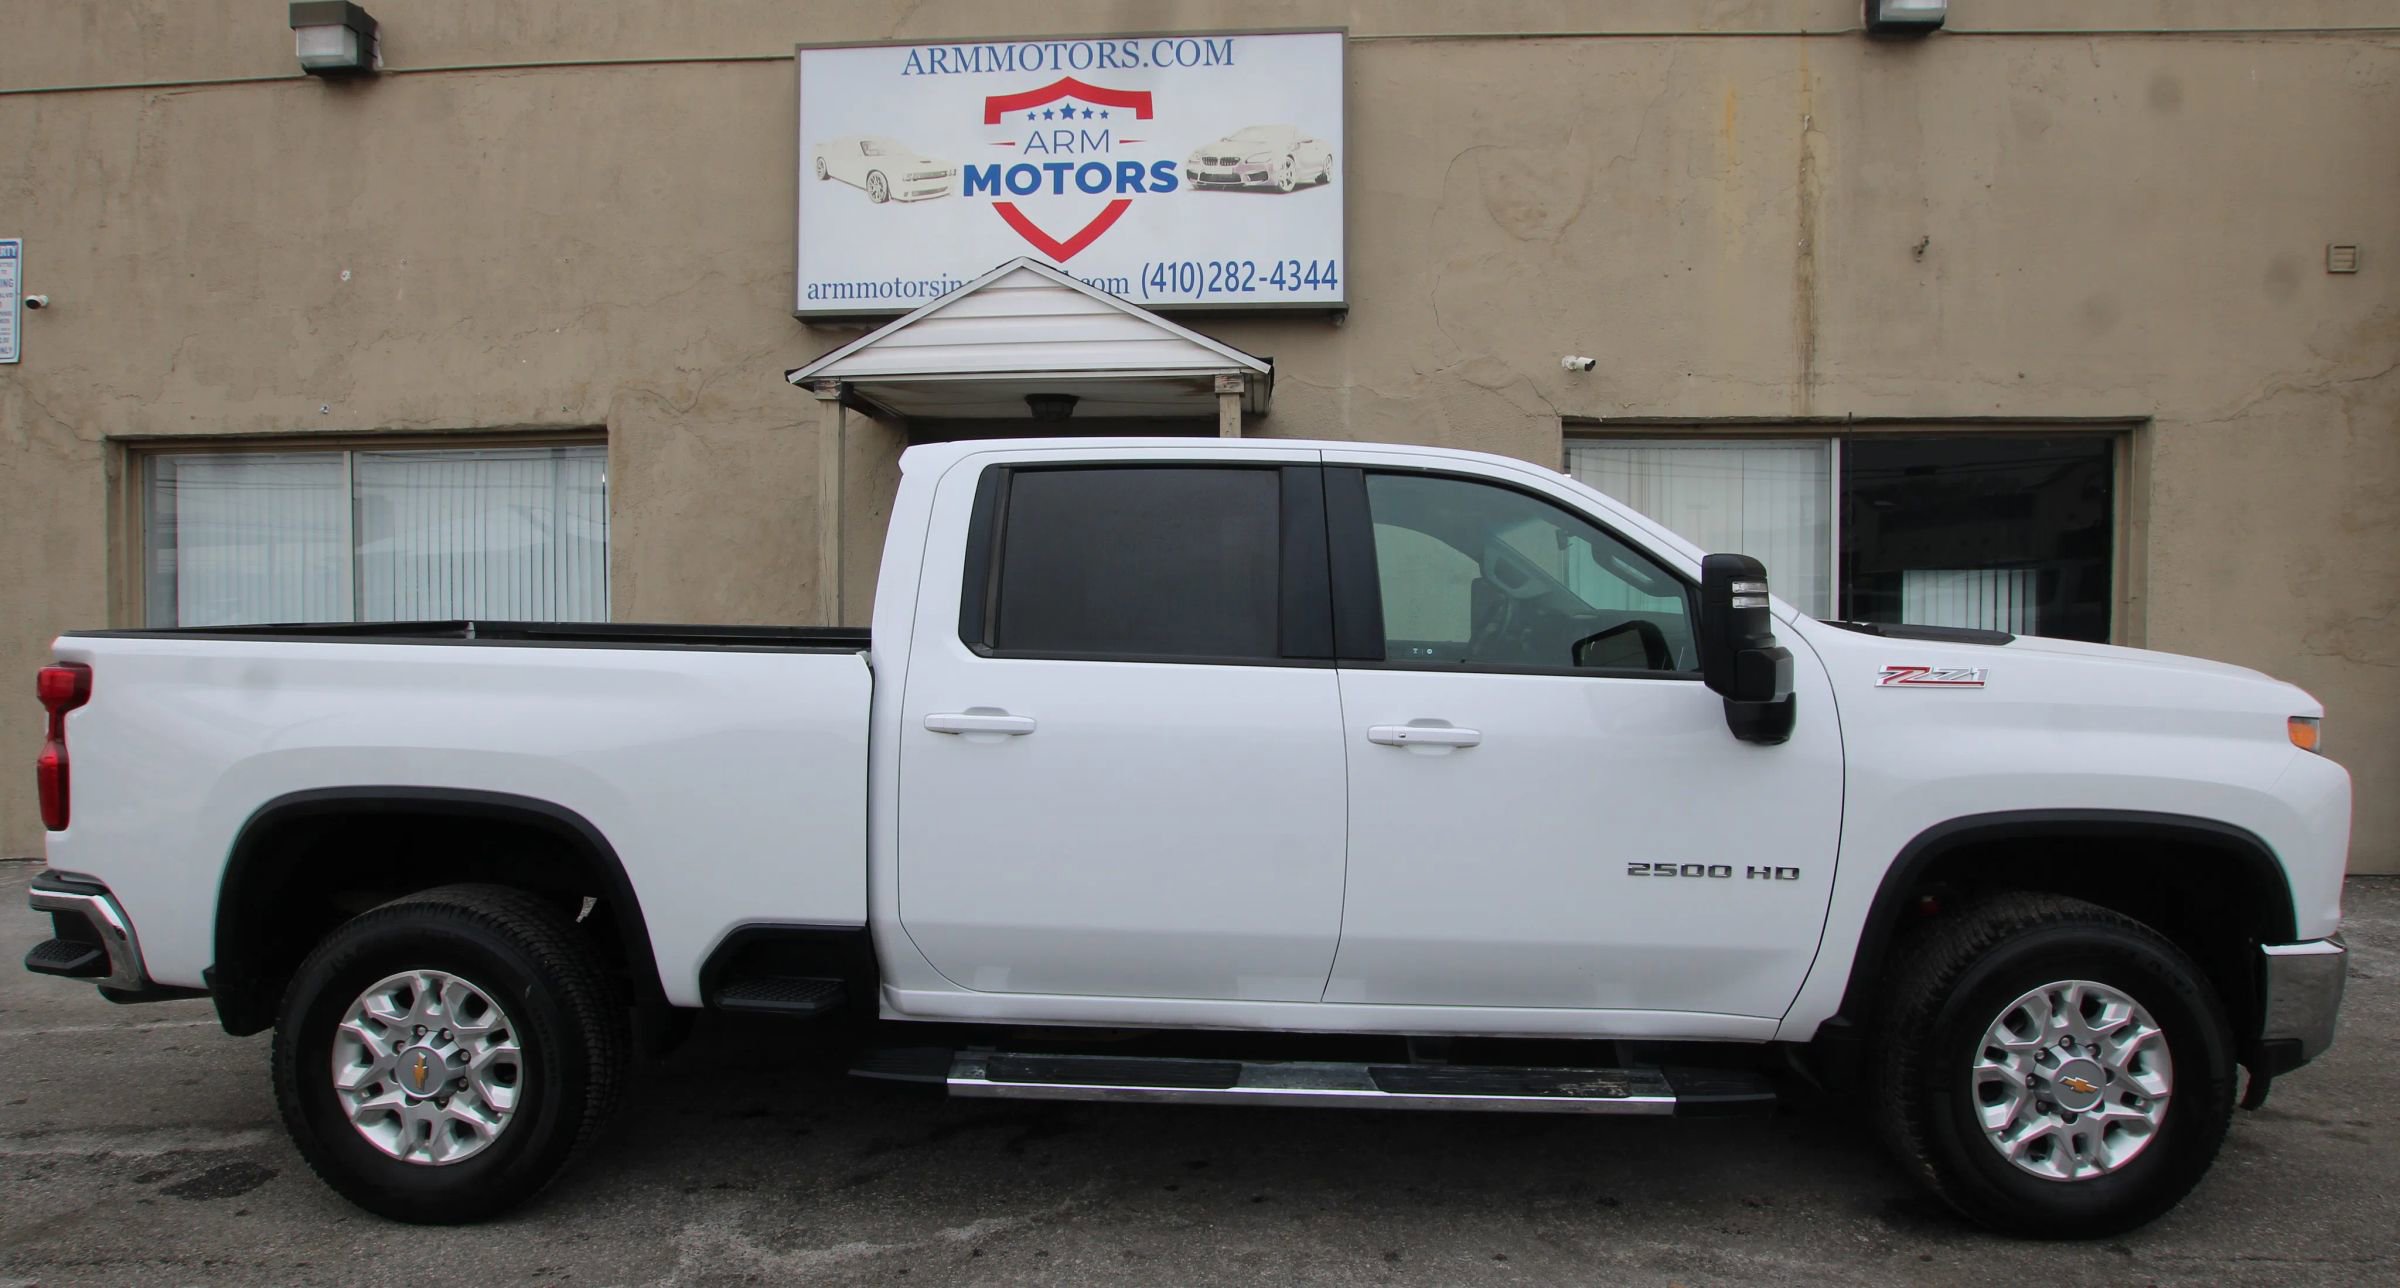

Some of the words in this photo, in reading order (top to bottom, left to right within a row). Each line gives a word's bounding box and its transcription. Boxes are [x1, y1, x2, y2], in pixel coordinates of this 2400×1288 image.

[902, 38, 1235, 76] ARMMOTORS.COM
[1023, 129, 1110, 155] ARM
[963, 160, 1179, 197] MOTORS
[1141, 260, 1338, 299] (410)282-4344
[1875, 665, 1991, 688] Z71
[1627, 862, 1732, 877] 2500
[1746, 865, 1800, 879] HD
